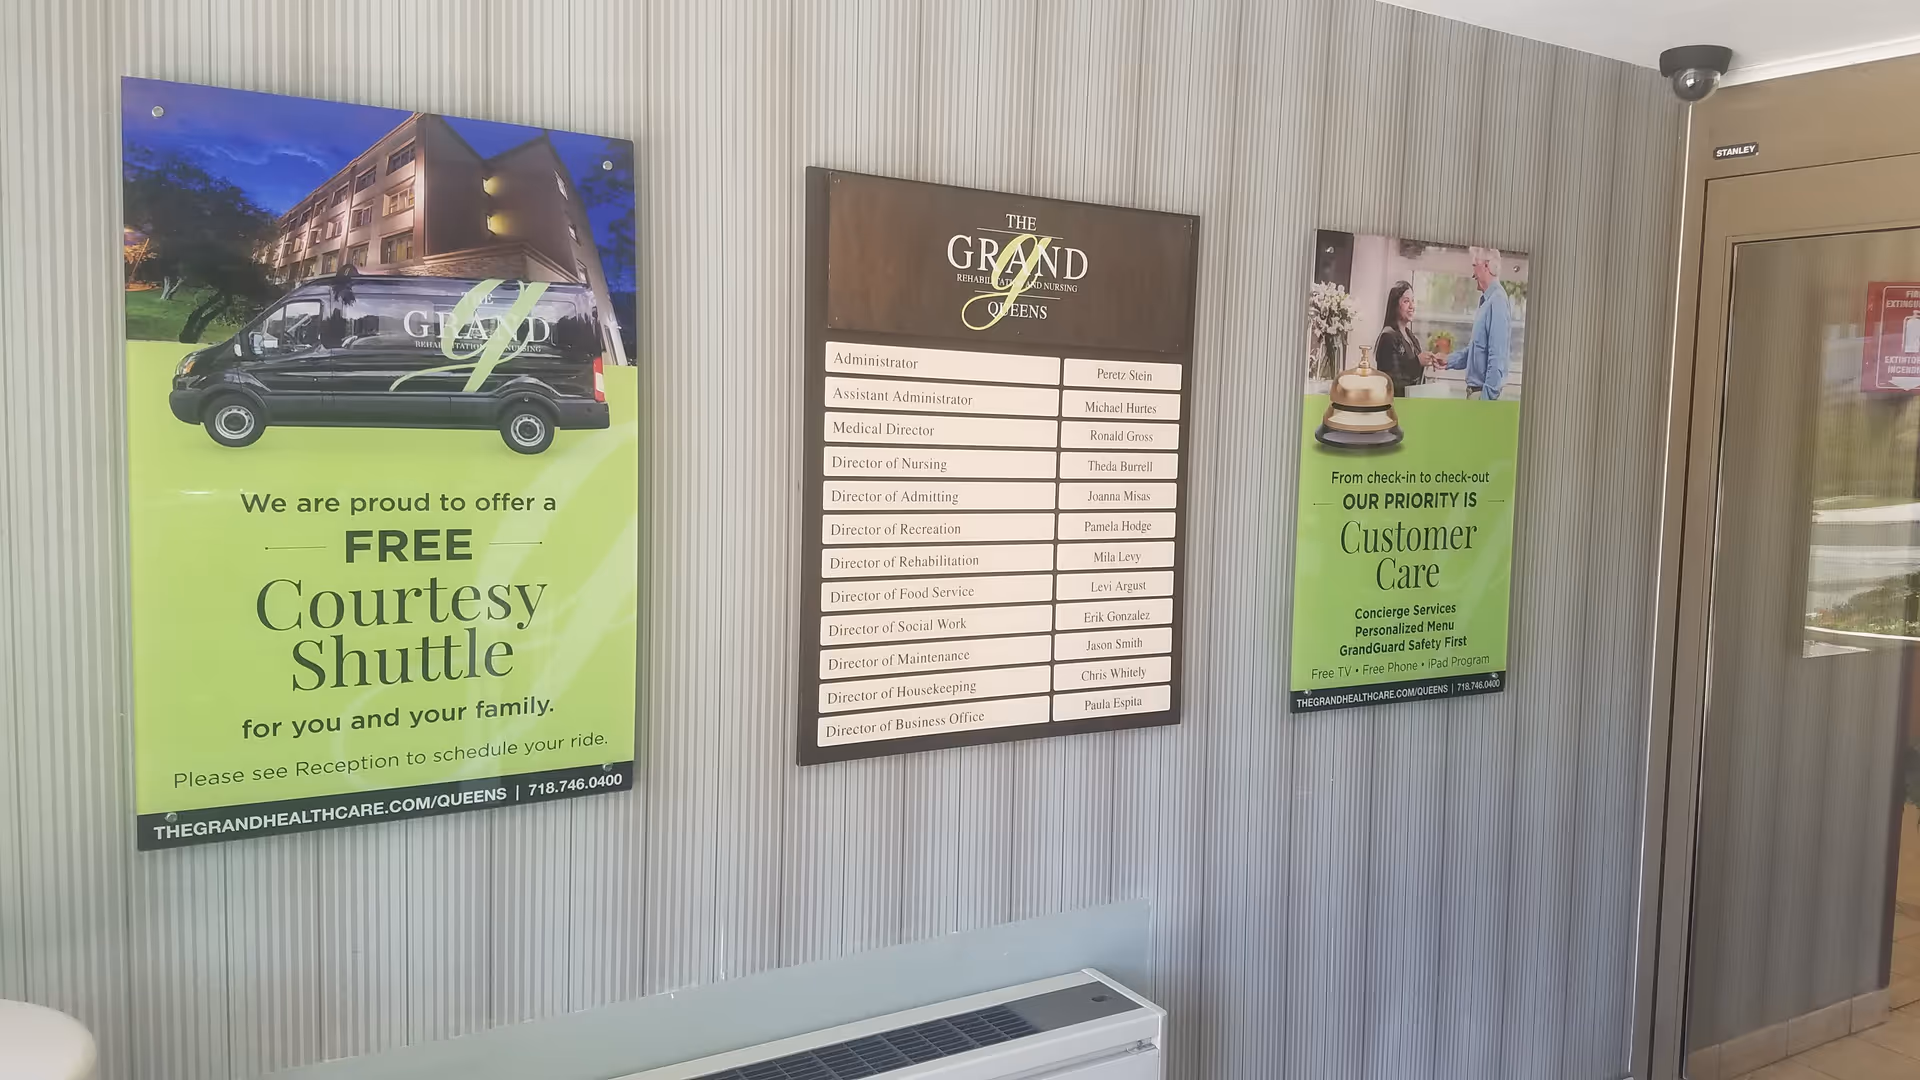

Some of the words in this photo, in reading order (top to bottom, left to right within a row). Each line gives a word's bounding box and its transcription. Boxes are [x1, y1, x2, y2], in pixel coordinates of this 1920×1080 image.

[1716, 145, 1756, 157] STANLEY
[1006, 213, 1037, 231] THE
[947, 234, 1089, 280] GRAND
[1044, 282, 1078, 293] NURSING
[404, 310, 550, 342] GRAND
[833, 352, 919, 370] Administrator
[1096, 367, 1127, 382] Peretz
[1128, 369, 1153, 382] Stein
[832, 387, 889, 402] Assistant
[892, 390, 973, 407] Administrator
[1085, 401, 1123, 414] Michael
[1126, 402, 1157, 415] Hurtes
[832, 421, 883, 435] Medical
[886, 423, 935, 437] Director
[1090, 430, 1124, 442] Ronald
[1126, 431, 1154, 443] Gross
[832, 456, 882, 469] Director
[885, 457, 900, 470] of
[901, 457, 947, 473] Nursing
[1087, 460, 1118, 472] Theda
[1120, 460, 1153, 473] Burrell
[1331, 471, 1363, 484] From
[1367, 471, 1416, 484] check-in
[1420, 472, 1431, 483] to
[1435, 470, 1489, 483] check-out
[241, 493, 287, 513] We
[296, 495, 340, 513] are
[350, 494, 430, 516] proud
[440, 494, 466, 512] to
[475, 493, 535, 511] offer
[543, 497, 556, 511] a
[831, 490, 882, 503] Director
[885, 490, 899, 503] of
[900, 490, 959, 505] Admitting
[1087, 490, 1121, 502] Joanna
[1123, 490, 1151, 501] Misas
[1343, 493, 1379, 510] OUR
[1384, 492, 1459, 509] PRIORITY
[1464, 492, 1477, 507] IS
[830, 523, 881, 536] Director
[883, 523, 898, 535] of
[900, 522, 961, 535] Recreation
[1084, 520, 1118, 533] Pamela
[1121, 519, 1152, 534] Hodge
[345, 529, 473, 563] FREE
[1340, 520, 1477, 554] Customer
[829, 556, 880, 570] Director
[882, 555, 897, 569] of
[899, 554, 979, 568] Rehabilitation
[1093, 551, 1116, 562] Mila
[1118, 551, 1142, 564] Levy
[1376, 557, 1440, 590] Care
[830, 589, 881, 603] Director
[883, 588, 897, 601] of
[899, 586, 929, 600] Food
[932, 585, 975, 599] Service
[1091, 580, 1112, 593] Levi
[1115, 580, 1147, 594] Argust
[256, 577, 548, 631] Courtesy
[1355, 606, 1410, 620] Concierge
[1413, 603, 1457, 615] Services
[1083, 611, 1104, 624] Erik
[1106, 610, 1150, 623] Gonzalez
[828, 622, 879, 637] Director
[881, 621, 895, 634] of
[898, 618, 934, 633] Social
[936, 618, 967, 632] Work
[1355, 621, 1424, 638] Personalized
[1427, 620, 1455, 632] Menu
[1085, 639, 1113, 652] Jason
[1115, 637, 1143, 650] Smith
[1339, 640, 1405, 657] GrandGuard
[1408, 638, 1441, 651] Safety
[1444, 635, 1467, 648] First
[292, 627, 514, 692] Shuttle
[828, 656, 878, 672] Director
[881, 654, 895, 668] of
[897, 650, 970, 666] Maintenance
[1311, 668, 1335, 680] Free
[1337, 665, 1352, 676] TV
[1362, 664, 1385, 675] Free
[1387, 661, 1418, 672] Phone
[1428, 657, 1449, 669] iPad
[1451, 654, 1490, 668] Program
[1081, 668, 1108, 682] Chris
[1110, 666, 1147, 681] Whitely
[827, 689, 878, 705] Director
[880, 687, 894, 700] of
[896, 680, 977, 698] Housekeeping
[1297, 684, 1448, 708] THEGRANDHEALTHCARE.COM/QUEENS
[1457, 679, 1500, 691] 718.746.0400
[1084, 698, 1111, 711] Paula
[1113, 696, 1142, 710] Espita
[242, 718, 282, 739] for
[291, 716, 341, 739] you
[351, 708, 400, 730] and
[409, 705, 467, 728] your
[476, 696, 555, 719] family.
[825, 722, 876, 739] Director
[879, 719, 893, 733] of
[895, 714, 946, 730] Business
[949, 711, 985, 724] Office
[173, 770, 244, 788] Please
[252, 764, 288, 780] see
[296, 752, 400, 777] Reception
[406, 749, 426, 765] to
[433, 739, 518, 763] schedule
[524, 736, 565, 756] your
[570, 731, 609, 748] ride.
[153, 787, 507, 841] THEGRANDHEALTHCARE.COM/QUEENS
[528, 773, 623, 797] 718.746.0400
